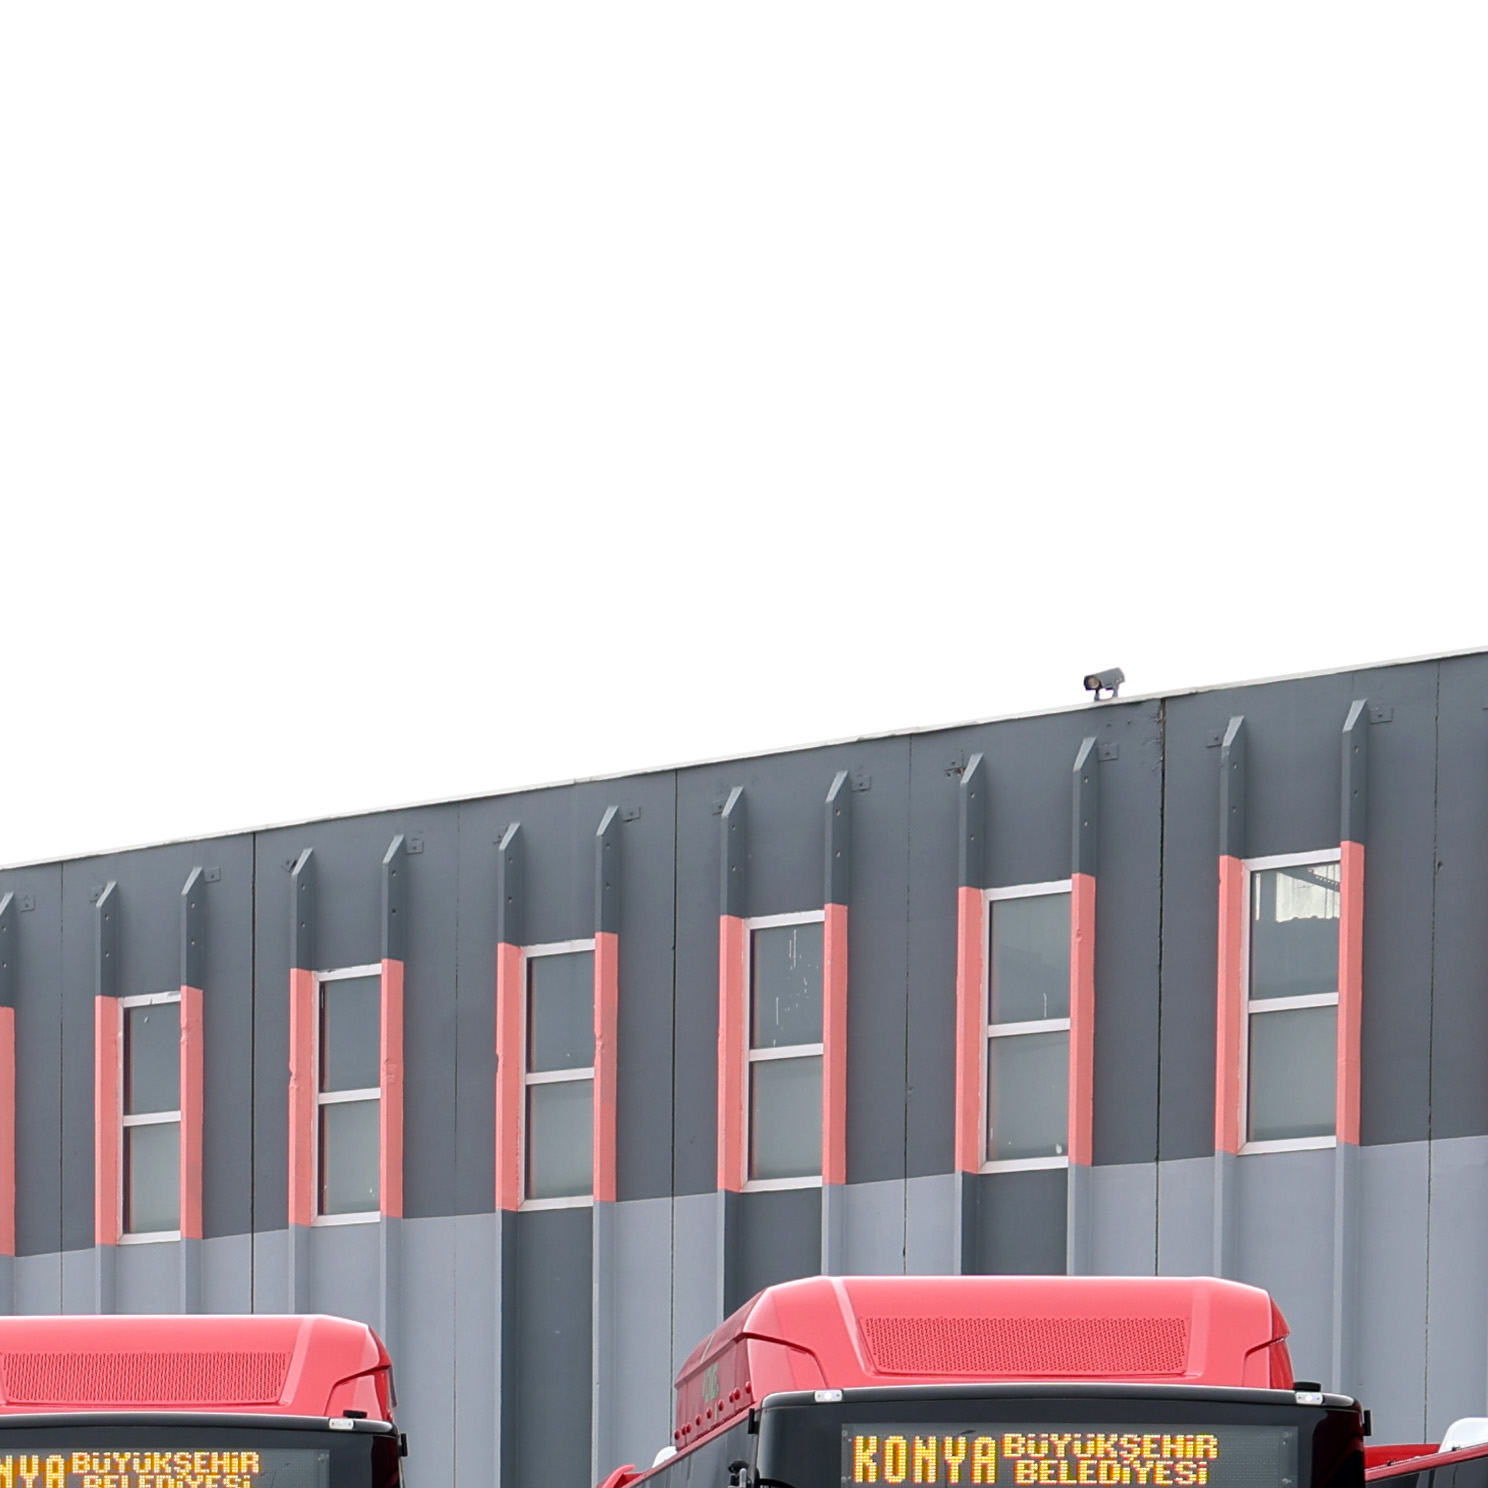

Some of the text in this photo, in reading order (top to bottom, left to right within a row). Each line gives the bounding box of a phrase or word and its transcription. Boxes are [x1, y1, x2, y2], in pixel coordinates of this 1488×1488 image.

[853, 1435, 998, 1483] KONYA
[1002, 1432, 1219, 1460] BÜYÜKŞEHİR
[72, 1451, 260, 1475] BÜYÜKŞEHİR
[1013, 1459, 1208, 1485] BELEDİYESİ
